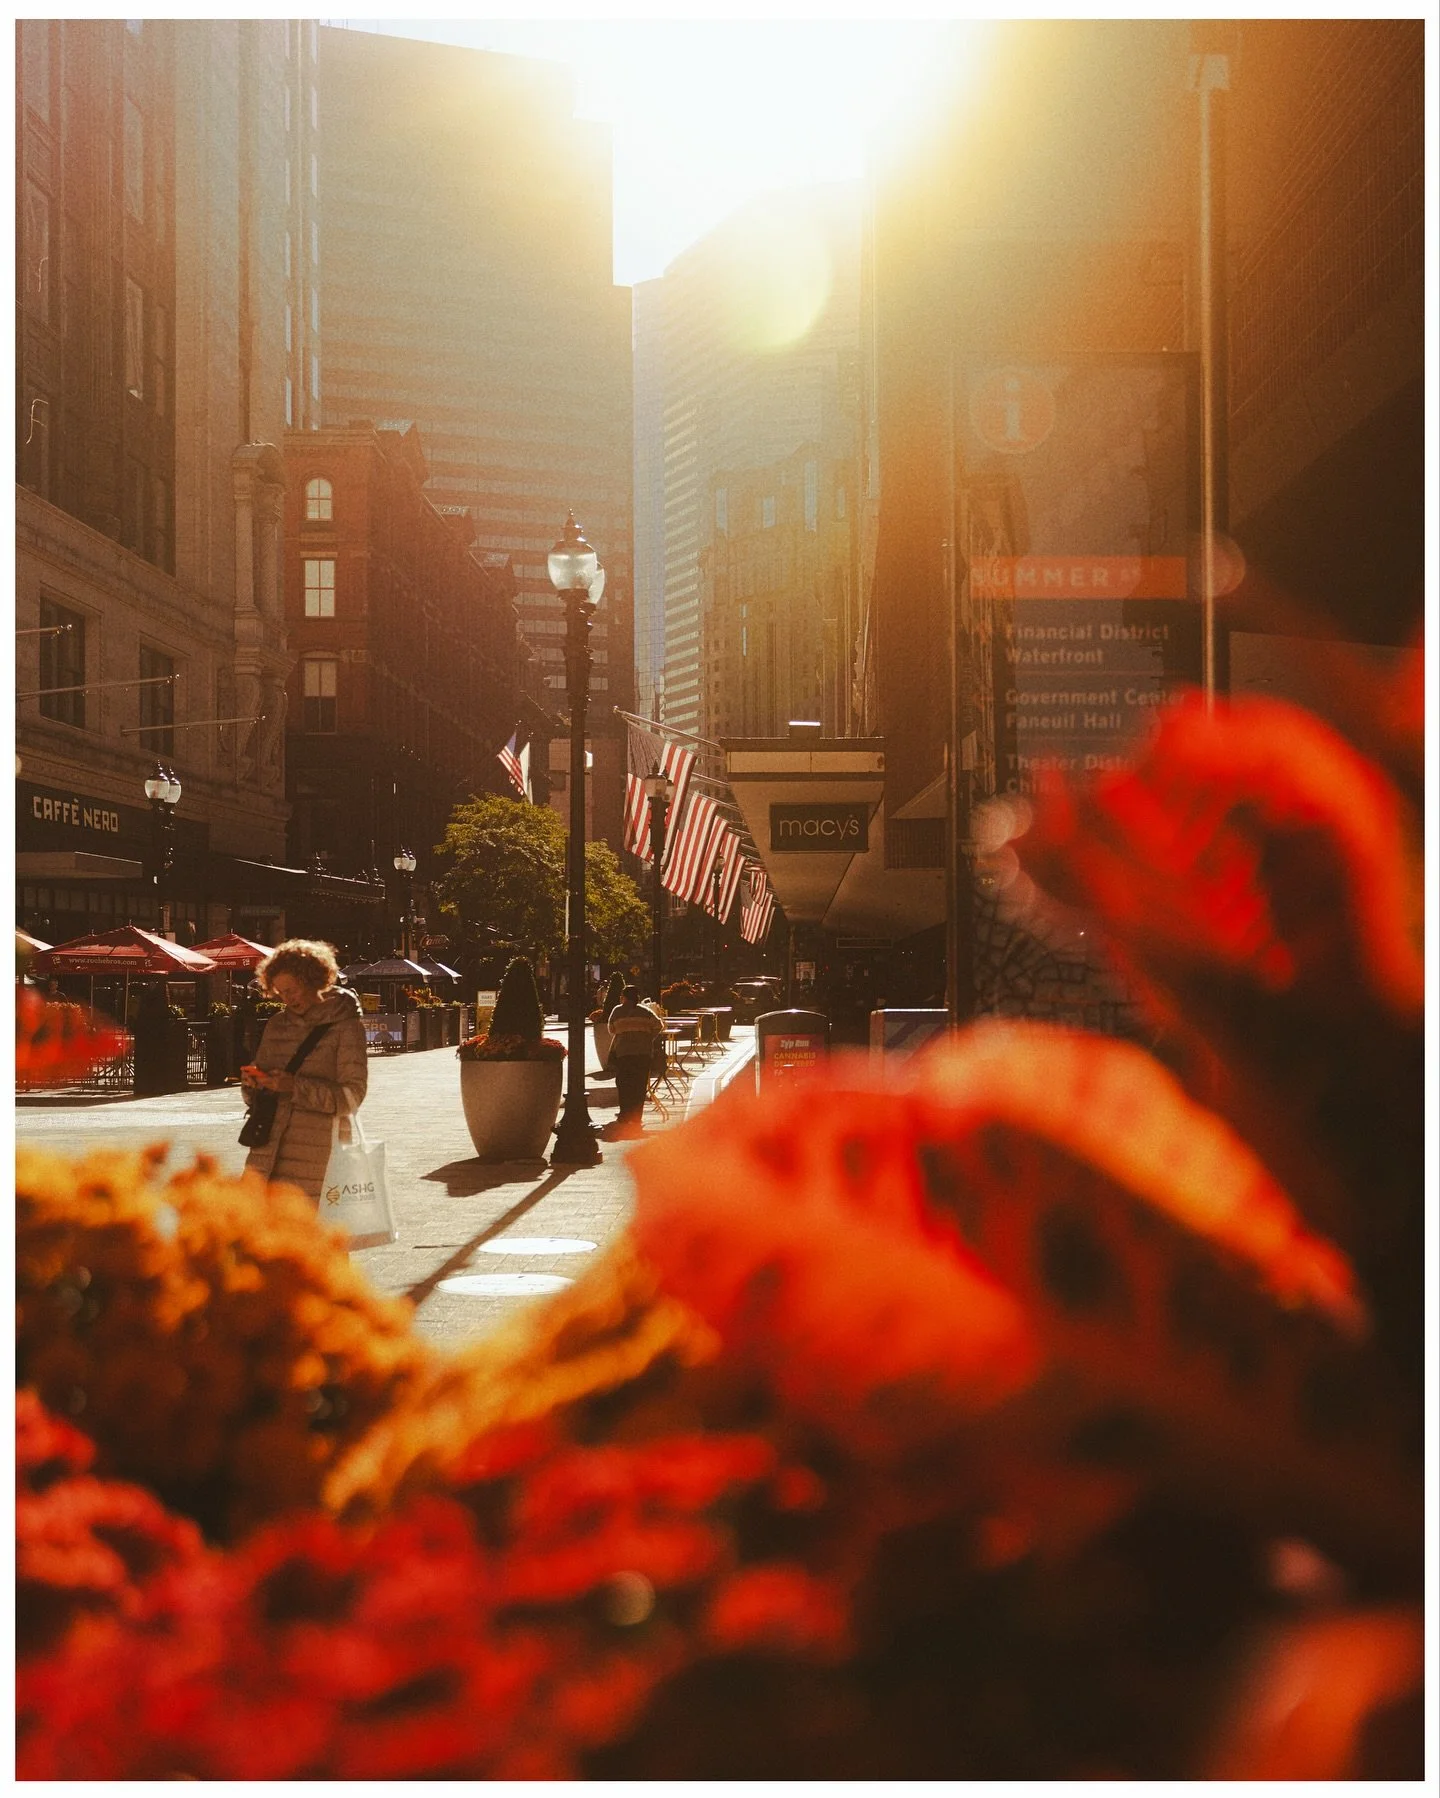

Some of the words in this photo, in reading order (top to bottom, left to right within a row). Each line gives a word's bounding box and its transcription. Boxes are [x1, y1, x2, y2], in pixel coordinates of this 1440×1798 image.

[971, 567, 1108, 586] SUMMER
[1005, 624, 1093, 640] Financial
[1101, 624, 1169, 640] District
[1006, 648, 1104, 664] Waterfront
[1006, 688, 1117, 705] Government
[1006, 713, 1075, 728] Faneuil
[1084, 713, 1122, 728] Hall
[33, 796, 80, 826] CAFFÈ
[84, 807, 119, 832] NERO
[69, 956, 137, 966] www.rochebros.com
[363, 1023, 388, 1031] ERO
[774, 1052, 816, 1060] CANNABIS
[342, 1182, 375, 1195] ASHG
